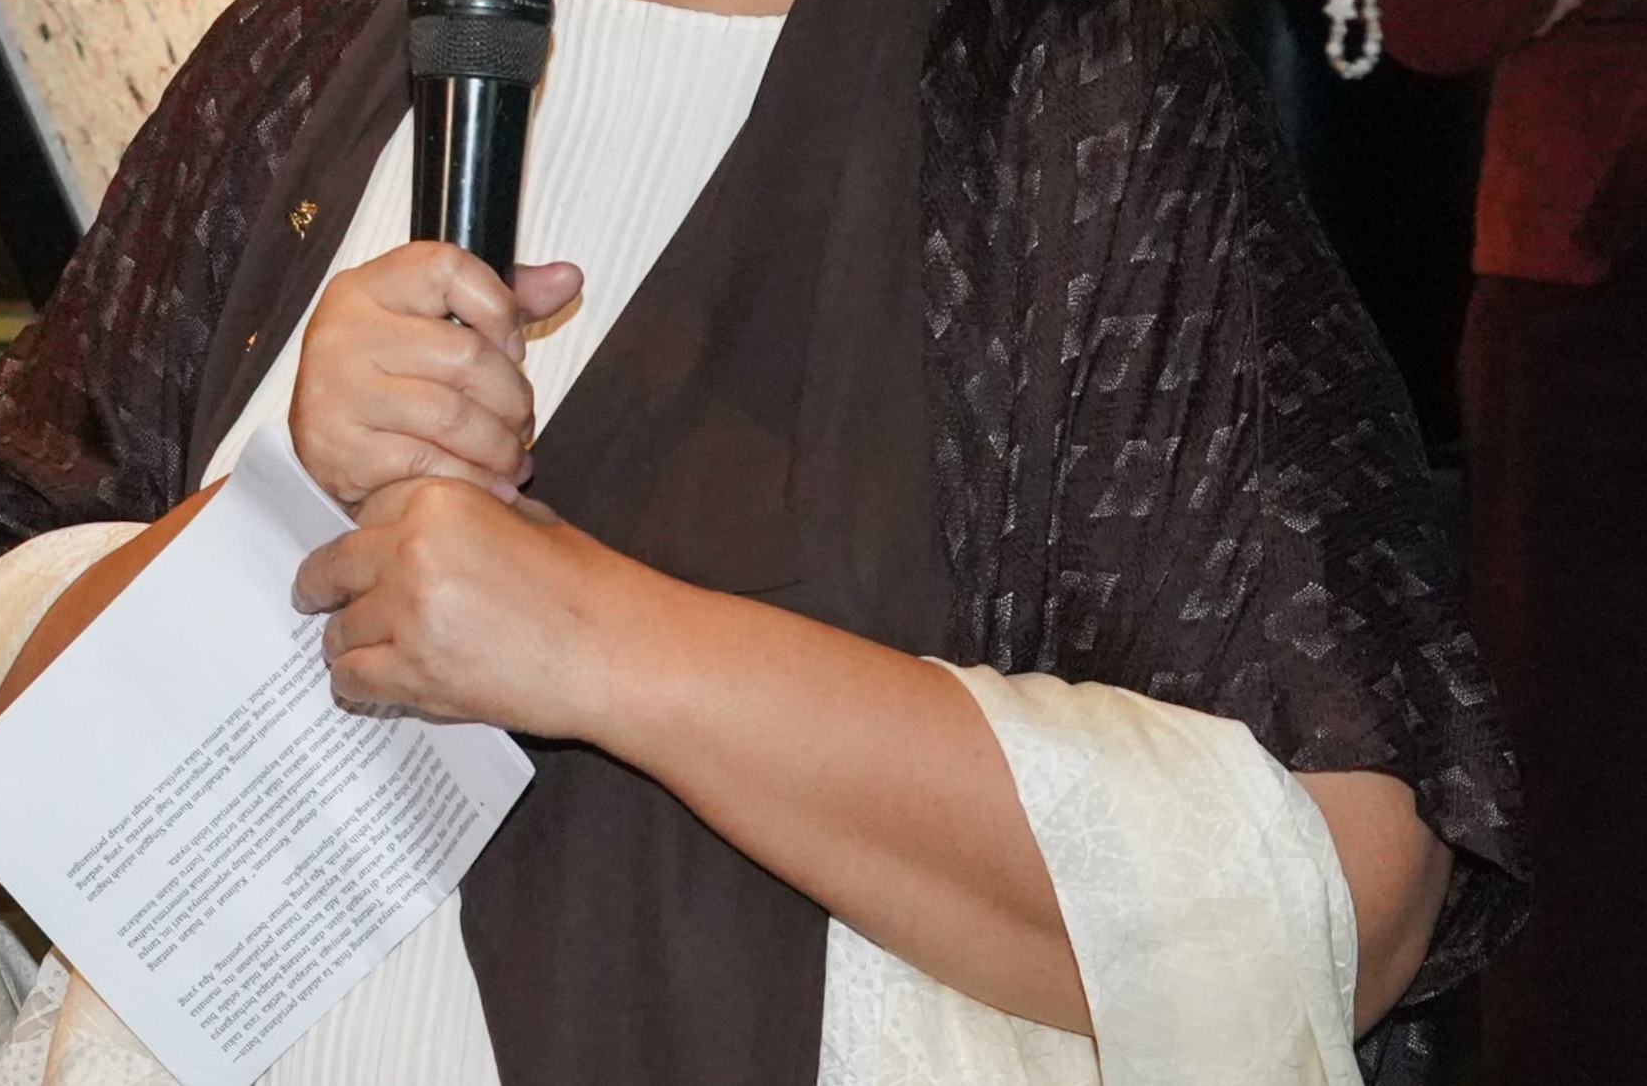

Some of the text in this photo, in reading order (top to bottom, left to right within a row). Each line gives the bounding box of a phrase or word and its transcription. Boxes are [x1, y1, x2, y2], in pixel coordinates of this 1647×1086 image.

[280, 650, 305, 674] berat
[251, 696, 278, 721] ruang
[285, 685, 311, 713] sosial
[223, 704, 251, 727] Tidak
[255, 707, 289, 739] menjadi
[200, 723, 227, 750] semua
[229, 719, 253, 743] aman
[292, 725, 316, 748] tulus
[307, 725, 337, 754] namun
[182, 747, 205, 767] luka
[213, 741, 231, 759] dan
[277, 744, 295, 762] dan
[320, 739, 346, 763] tanpa
[173, 755, 214, 797] penguatan
[281, 752, 310, 779] makna
[285, 760, 323, 797] menunda
[190, 764, 232, 803] Kehadiran
[239, 759, 282, 800] kepedulian
[262, 777, 285, 798] tidak
[317, 770, 359, 809] Berdamai
[373, 782, 389, 799] apa
[130, 793, 156, 818] tetapi
[154, 796, 176, 817] bagi
[163, 799, 195, 828] Rumah
[208, 796, 242, 830] menjadi
[236, 794, 265, 824] pernah
[275, 787, 319, 829] Keberanian
[353, 794, 377, 817] yang
[369, 799, 395, 824] secara
[107, 815, 132, 840] setiap
[124, 814, 155, 845] mereka
[289, 807, 318, 836] dengan
[332, 813, 360, 838] harus
[348, 822, 374, 844] lebih
[368, 822, 392, 846] yang
[134, 825, 168, 856] Singgah
[189, 825, 214, 847] lebih
[210, 826, 257, 869] Keberanian
[252, 825, 278, 851] untuk
[385, 841, 397, 854] di
[66, 835, 109, 879] perjuangan
[102, 841, 125, 865] yang
[110, 852, 137, 880] adalah
[178, 852, 206, 879] Justru
[230, 847, 257, 872] hidup
[338, 843, 372, 877] menguji
[378, 852, 408, 880] makna
[74, 863, 104, 892] sedang
[187, 866, 213, 891] untuk
[308, 865, 327, 883] Apa
[357, 852, 386, 881] sekitar
[86, 876, 115, 903] bagian
[155, 876, 180, 901] dalam
[186, 868, 233, 913] sepenuhnya
[216, 875, 249, 907] Kalimat
[288, 878, 312, 902] yang
[299, 873, 342, 911] keyakinan.
[368, 878, 380, 891] di
[400, 877, 429, 903] bukan
[151, 887, 191, 926] menerima
[202, 905, 217, 920] ini
[322, 894, 341, 913] Ada
[344, 886, 372, 913] tengah
[117, 899, 159, 938] kesadaran
[170, 910, 192, 930] hari
[244, 898, 294, 945] benar-benar
[274, 911, 303, 937] Dalam
[350, 898, 385, 928] Tentang
[376, 900, 404, 926] hanya
[126, 922, 156, 949] bahwa
[177, 917, 205, 943] bukan
[280, 910, 326, 953] kecemasan
[308, 929, 326, 947] dan
[318, 926, 353, 960] menjaga
[347, 922, 380, 952] tentang
[137, 937, 162, 961] tanpa
[146, 942, 179, 973] tentang
[235, 933, 276, 975] perjalanan
[259, 949, 282, 972] yang
[278, 944, 312, 975] tentang
[330, 948, 353, 968] fisik.
[197, 971, 216, 989] Apa
[239, 970, 263, 992] tidak
[254, 971, 285, 998] betapa
[286, 958, 321, 990] harapan
[321, 966, 335, 978] Ia
[176, 984, 200, 1008] yang
[216, 989, 241, 1013] selalu
[296, 974, 324, 1002] adalah
[189, 986, 223, 1018] manusia
[260, 989, 288, 1014] ketika
[199, 1011, 220, 1030] bisa
[210, 995, 259, 1041] berharganya
[242, 1013, 262, 1032] rasa
[257, 997, 299, 1038] perjalanan
[220, 1030, 244, 1054] takut
